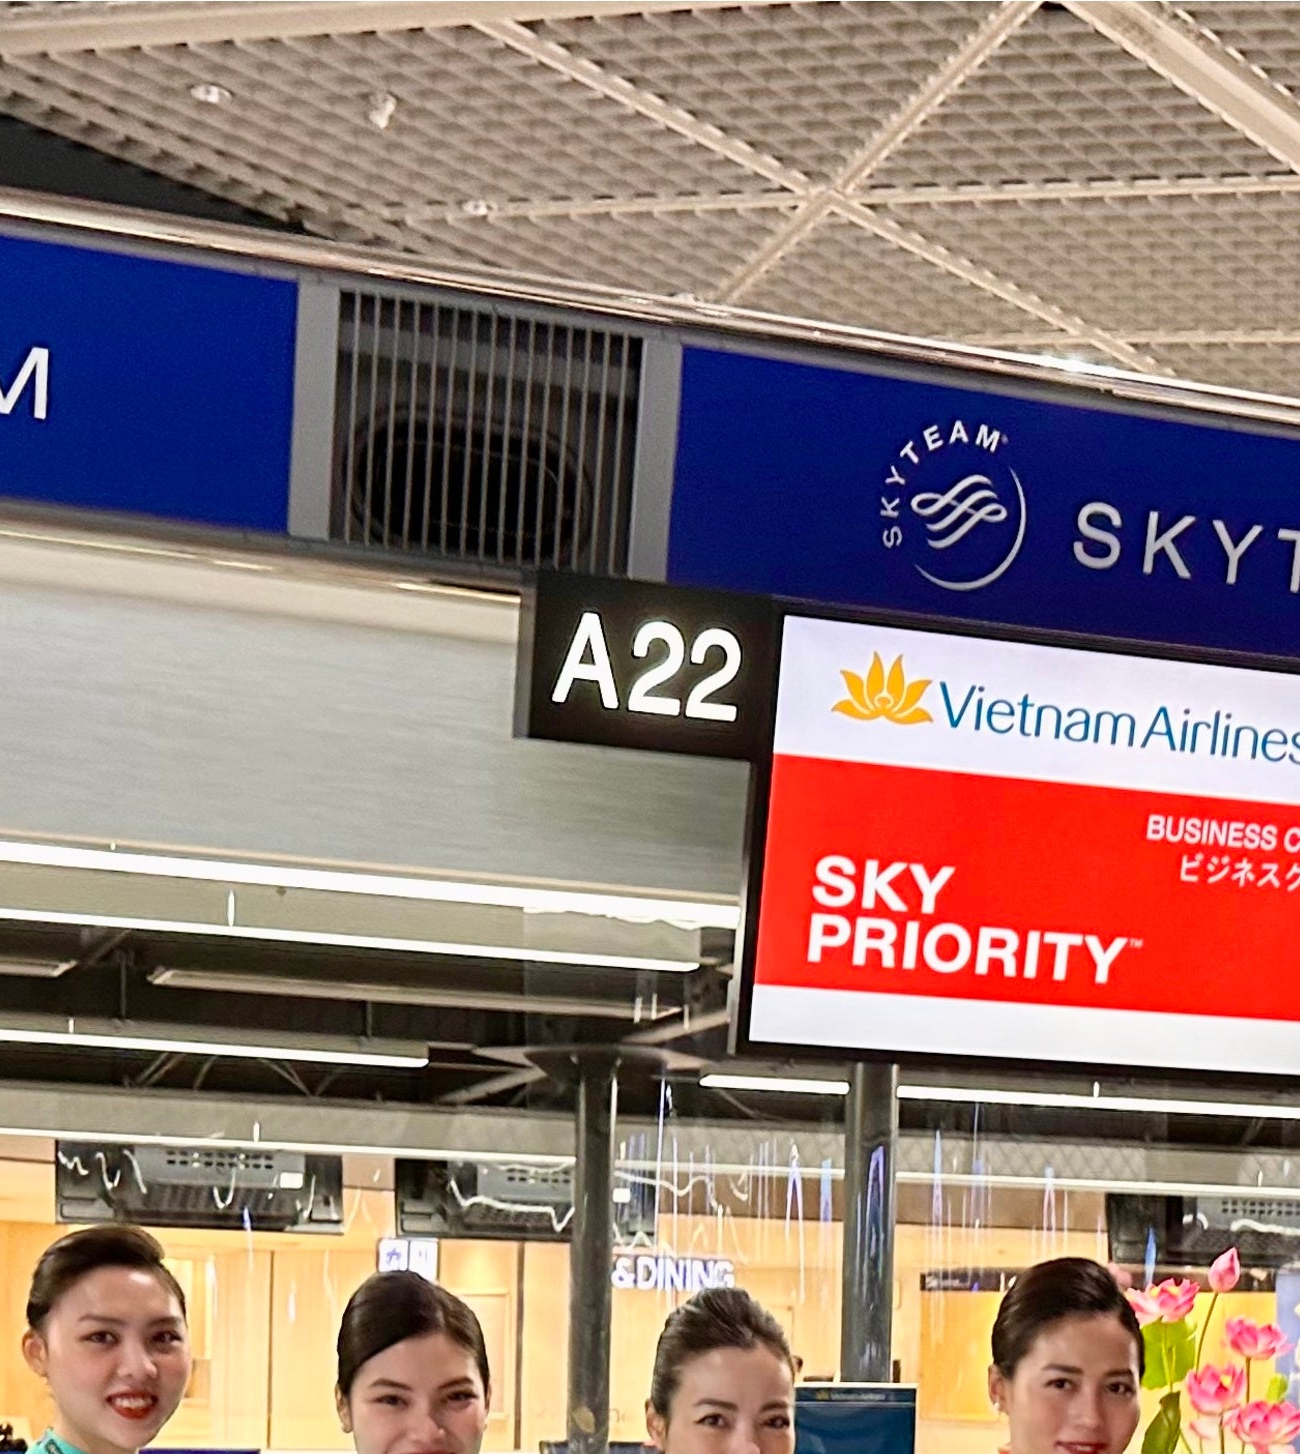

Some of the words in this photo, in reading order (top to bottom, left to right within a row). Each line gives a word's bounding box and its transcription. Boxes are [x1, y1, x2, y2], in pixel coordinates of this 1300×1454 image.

[880, 418, 1001, 547] SKYTEAM
[550, 611, 742, 722] A22
[1145, 814, 1278, 851] BUSINESS
[811, 854, 956, 914] SKY
